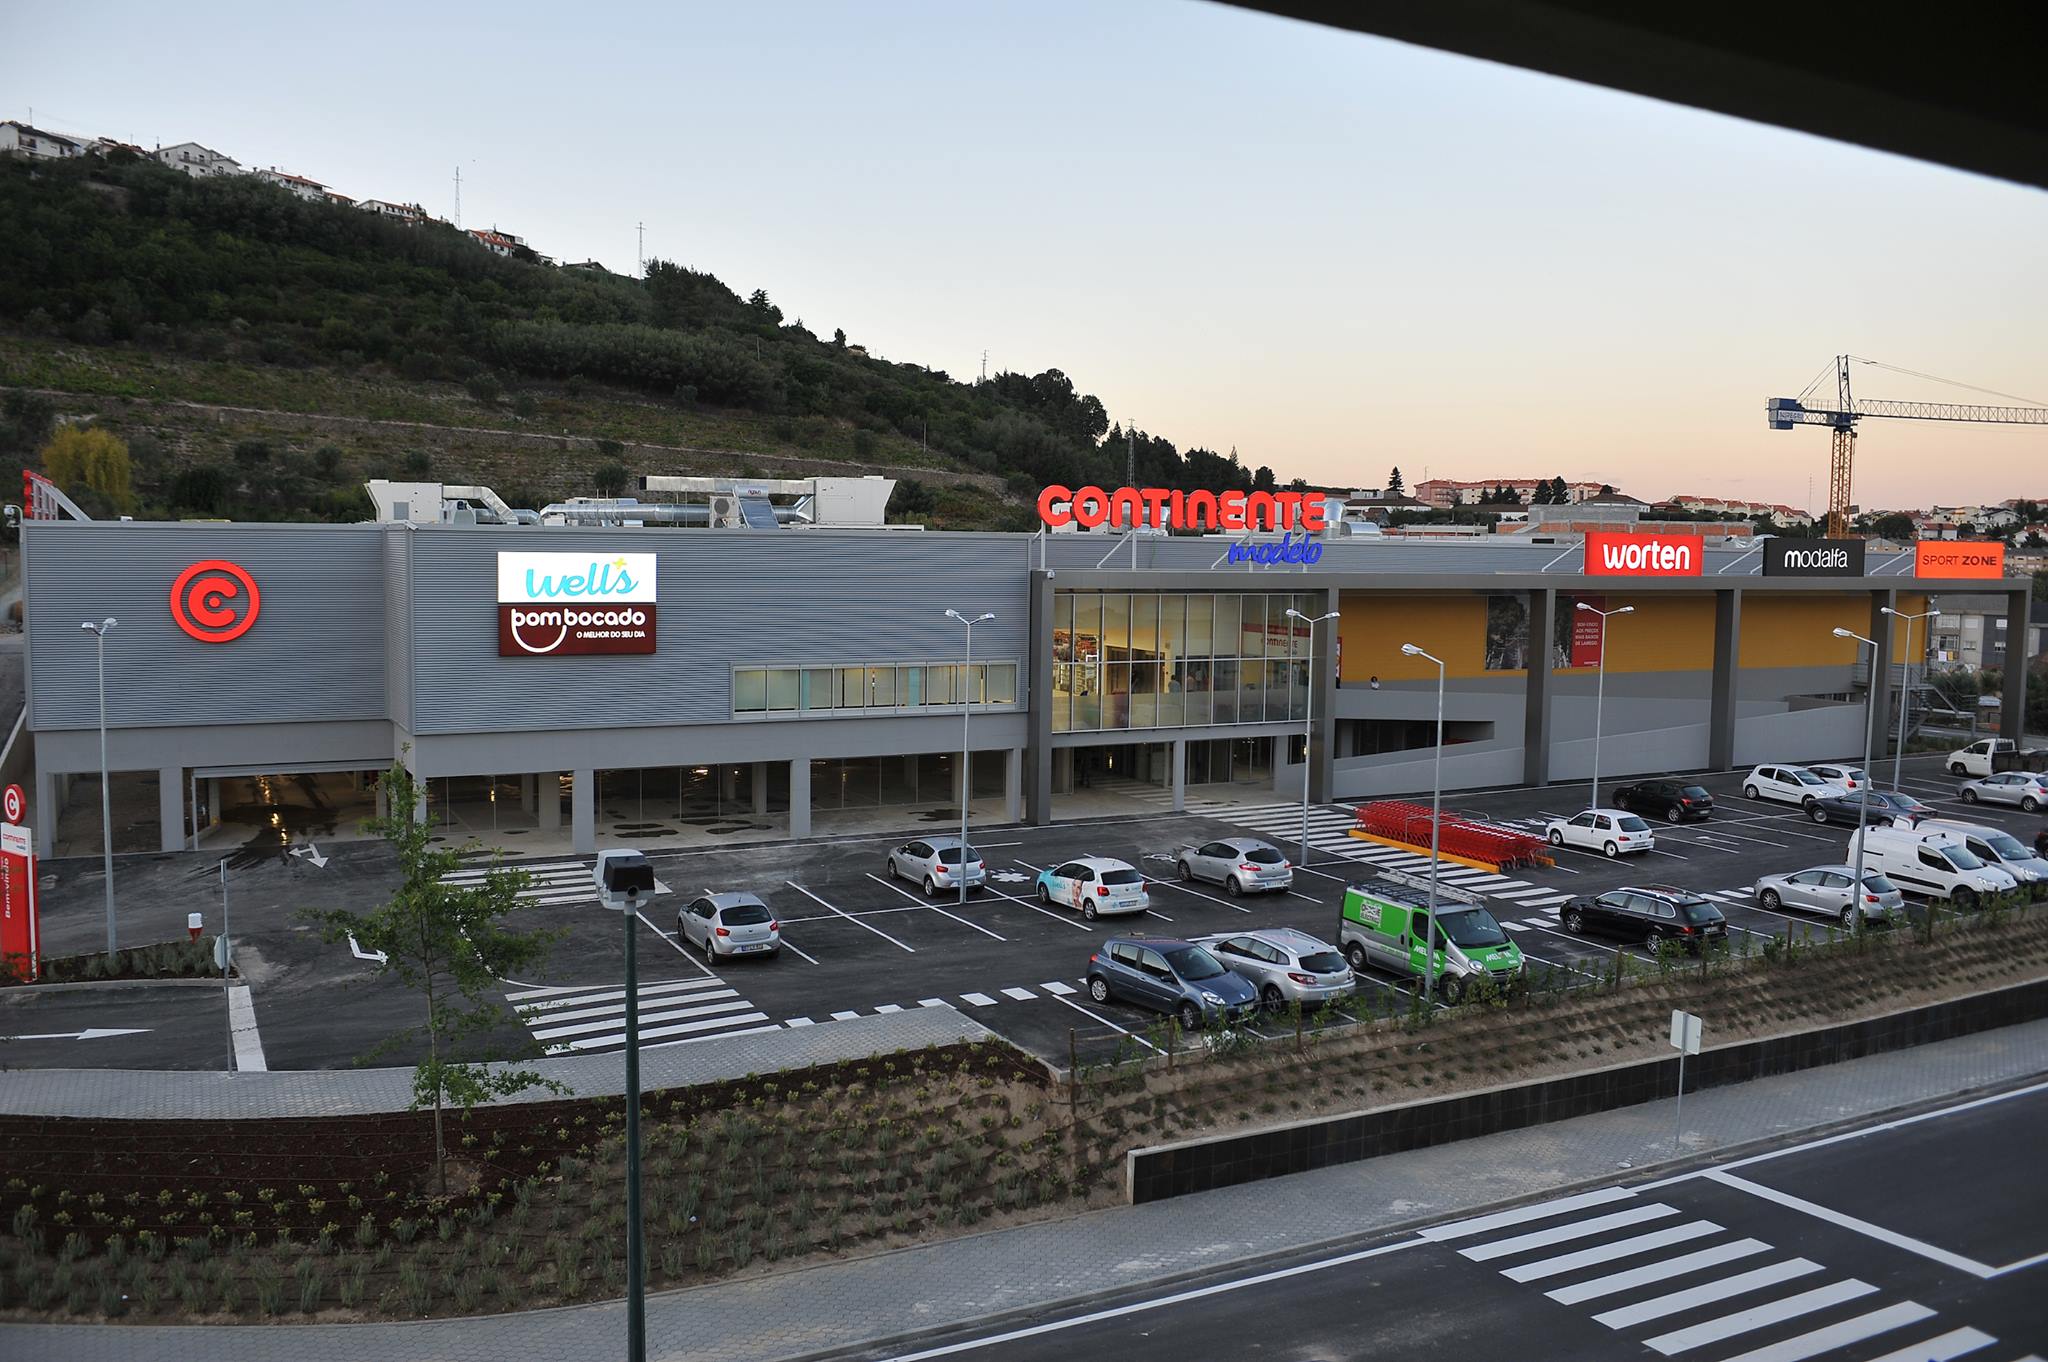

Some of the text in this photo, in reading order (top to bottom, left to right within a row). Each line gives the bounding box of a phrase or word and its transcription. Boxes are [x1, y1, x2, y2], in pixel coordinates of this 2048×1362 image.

[1037, 485, 1325, 531] CONTINENTE
[1227, 532, 1323, 565] modelo
[1602, 540, 1690, 569] worten
[1784, 547, 1848, 568] modalfa
[1922, 555, 1997, 566] SPORT ZONE
[564, 608, 646, 627] bocado
[576, 631, 583, 639] O
[610, 630, 621, 638] DO
[621, 630, 634, 638] SEU
[634, 630, 645, 638] DIA
[1414, 945, 1441, 961] MELM
